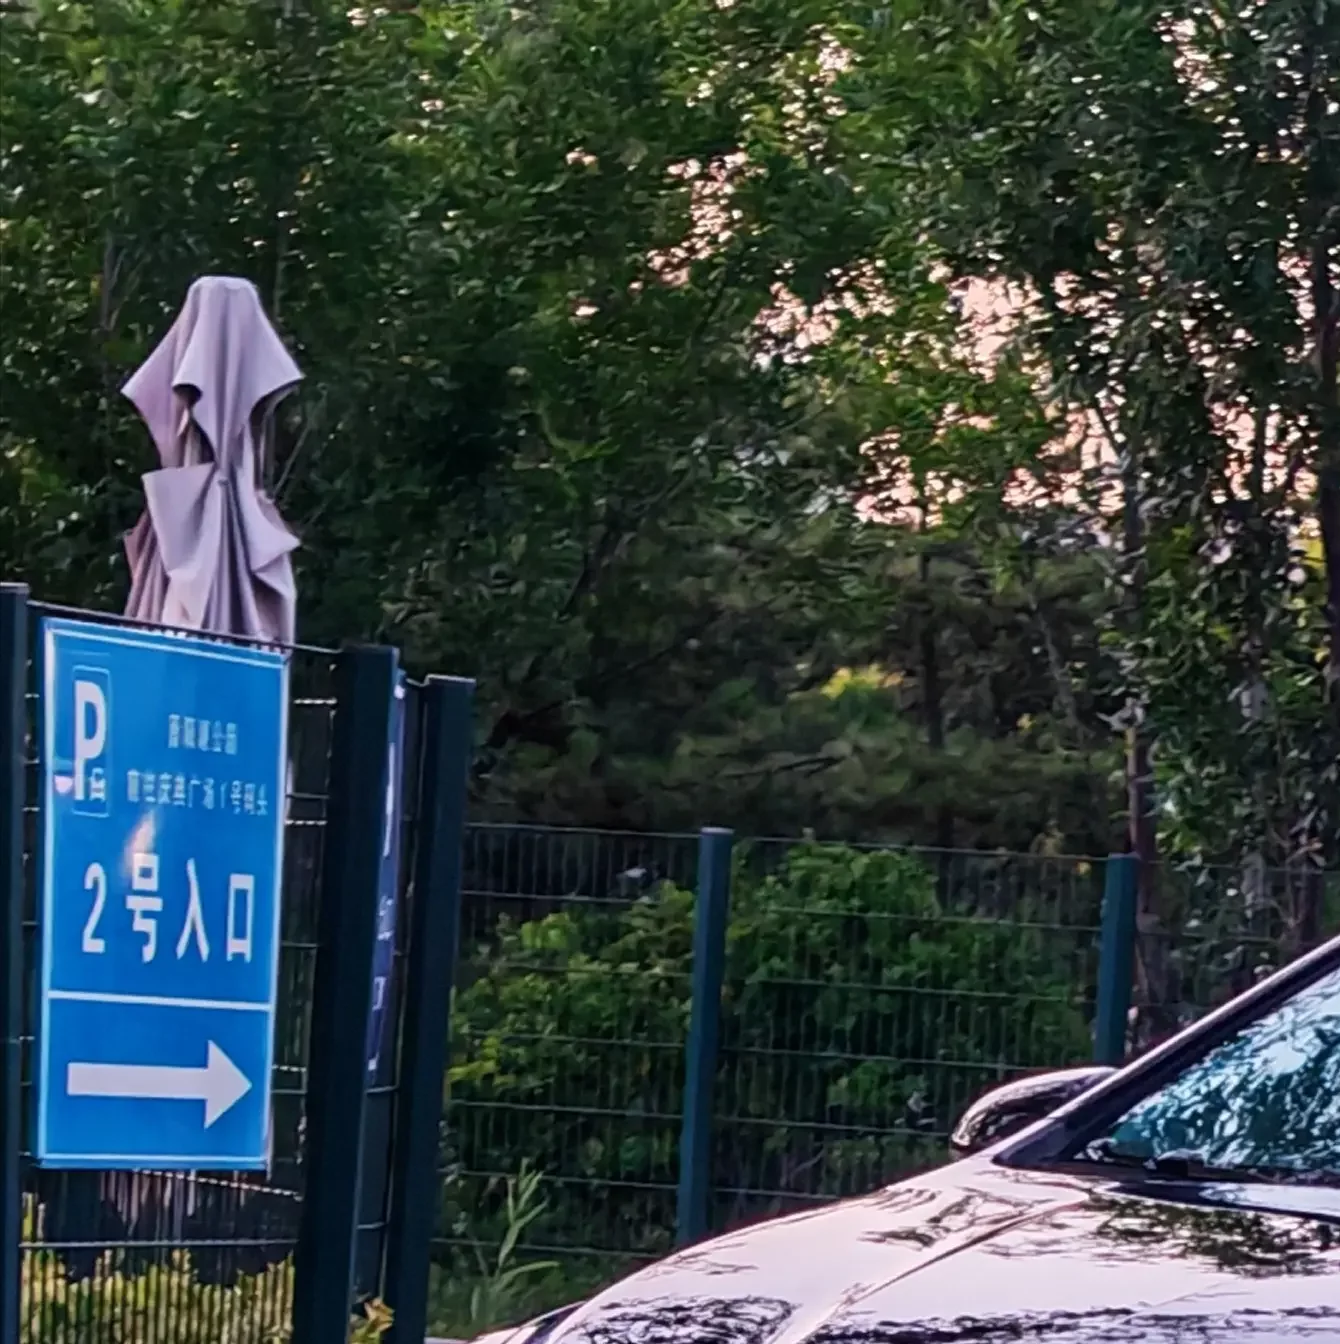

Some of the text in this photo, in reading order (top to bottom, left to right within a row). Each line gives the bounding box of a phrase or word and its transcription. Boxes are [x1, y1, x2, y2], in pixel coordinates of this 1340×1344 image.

[75, 680, 106, 800] P
[82, 852, 254, 963] 2号入口
